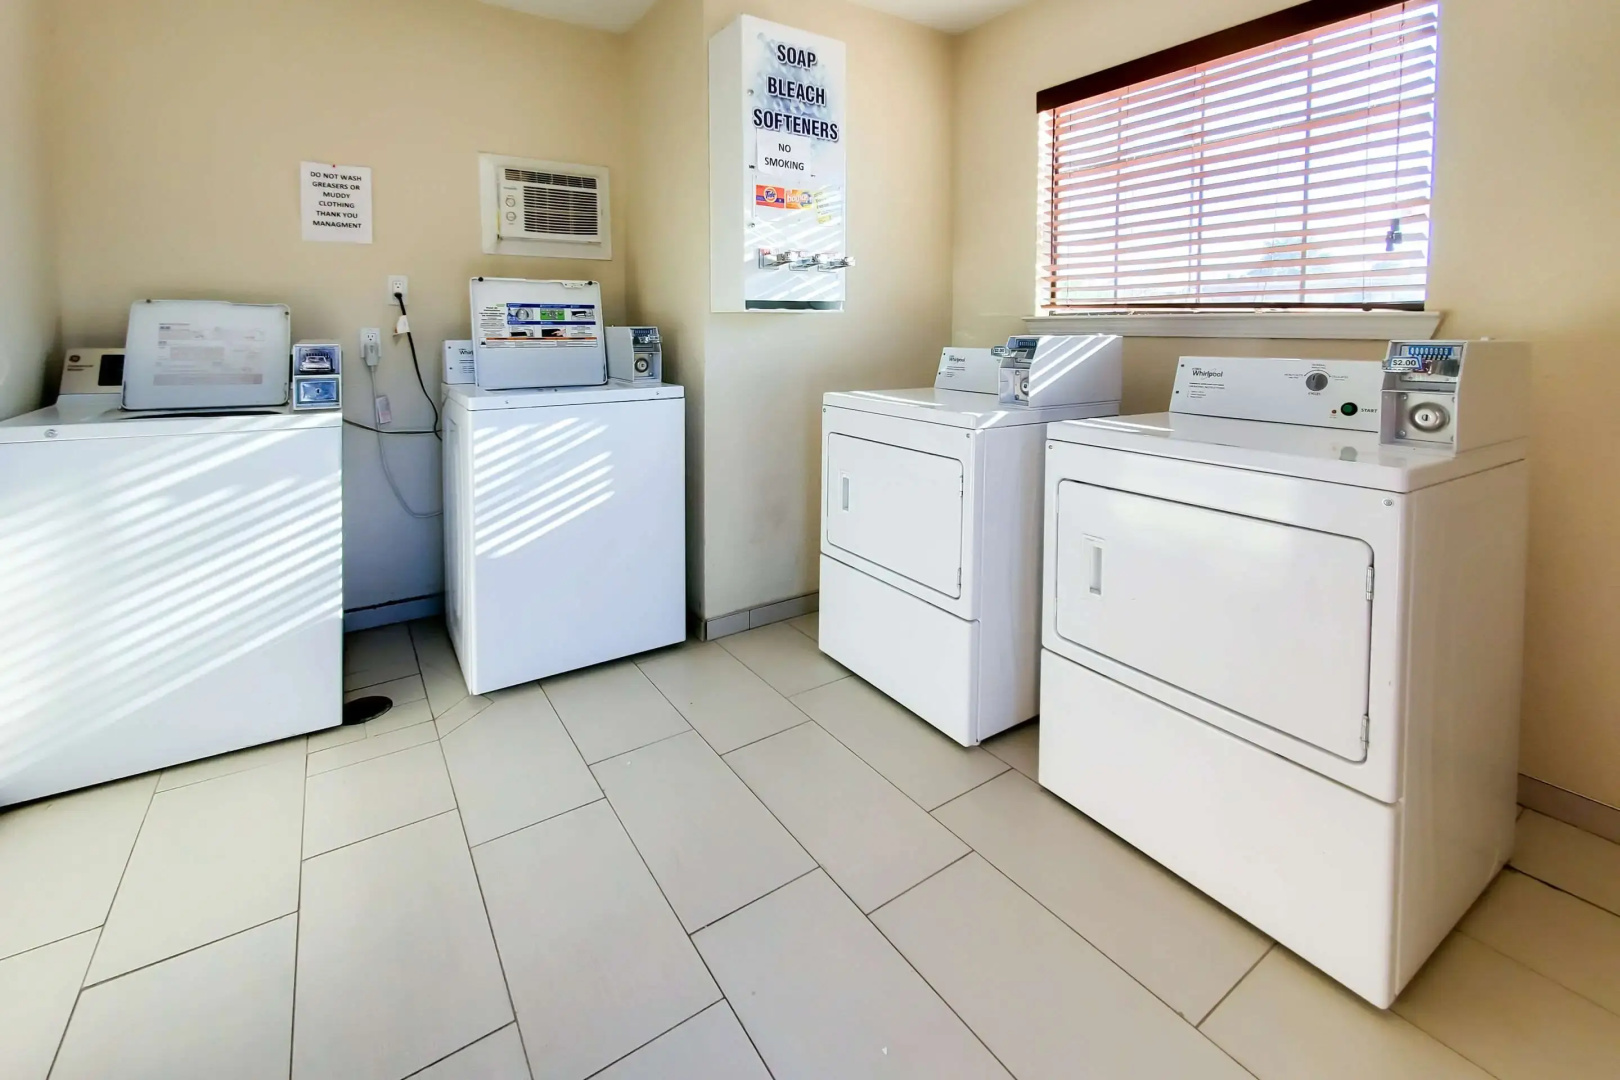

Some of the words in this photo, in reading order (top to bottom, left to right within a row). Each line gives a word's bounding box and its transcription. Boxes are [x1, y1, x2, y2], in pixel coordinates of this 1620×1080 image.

[777, 44, 817, 69] SOAP
[767, 76, 826, 105] BLEACH
[753, 108, 839, 141] SOFTENERS
[778, 143, 792, 153] NO
[764, 157, 805, 171] SMOKING
[312, 181, 348, 190] GREASERS
[765, 190, 776, 200] Tide
[318, 200, 355, 208] CLOTHING
[316, 210, 341, 218] THANK
[312, 220, 362, 228] MANAGMENT
[1192, 370, 1224, 378] Whirlpool
